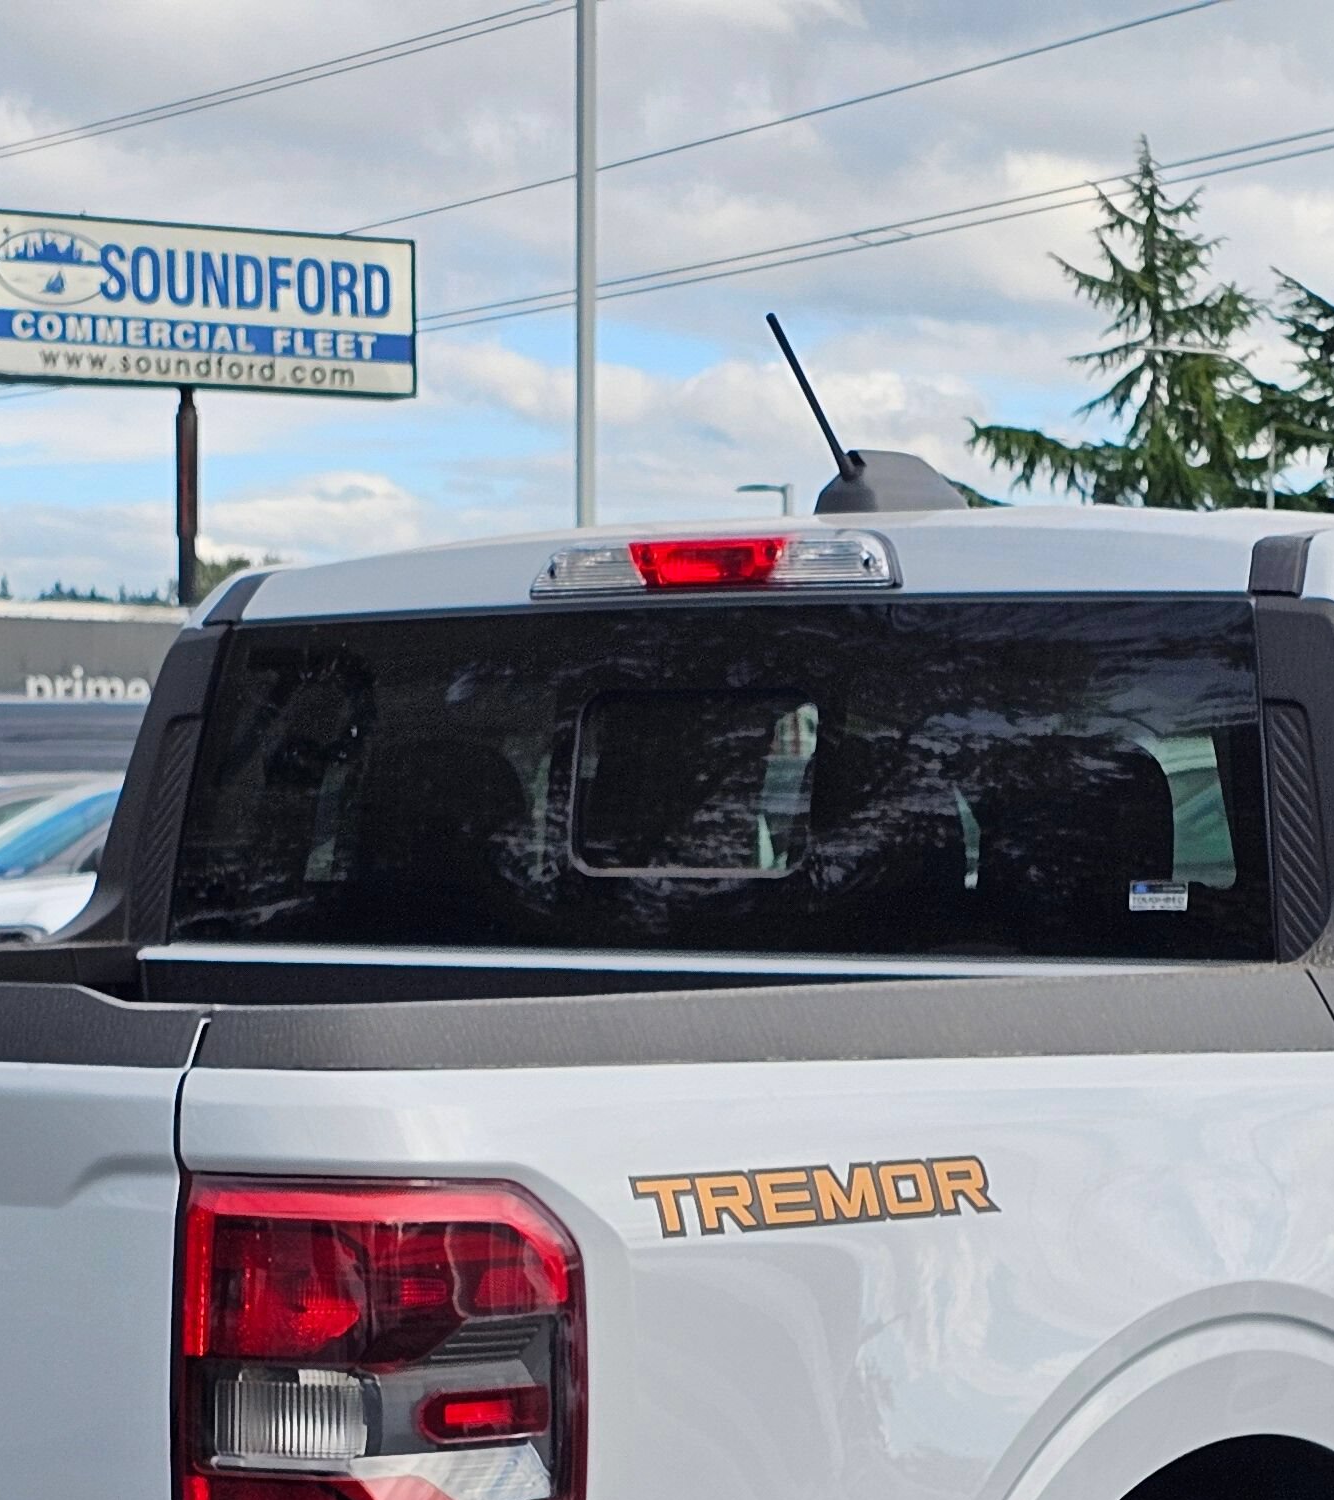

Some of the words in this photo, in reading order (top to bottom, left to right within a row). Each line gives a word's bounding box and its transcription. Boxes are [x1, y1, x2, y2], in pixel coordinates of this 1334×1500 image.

[100, 243, 391, 319] SOUNDFORD
[11, 311, 254, 354] COMMERCIAL
[273, 332, 378, 361] FLEET
[38, 348, 356, 387] www.soundford.com
[628, 1155, 1002, 1239] TREMOR
